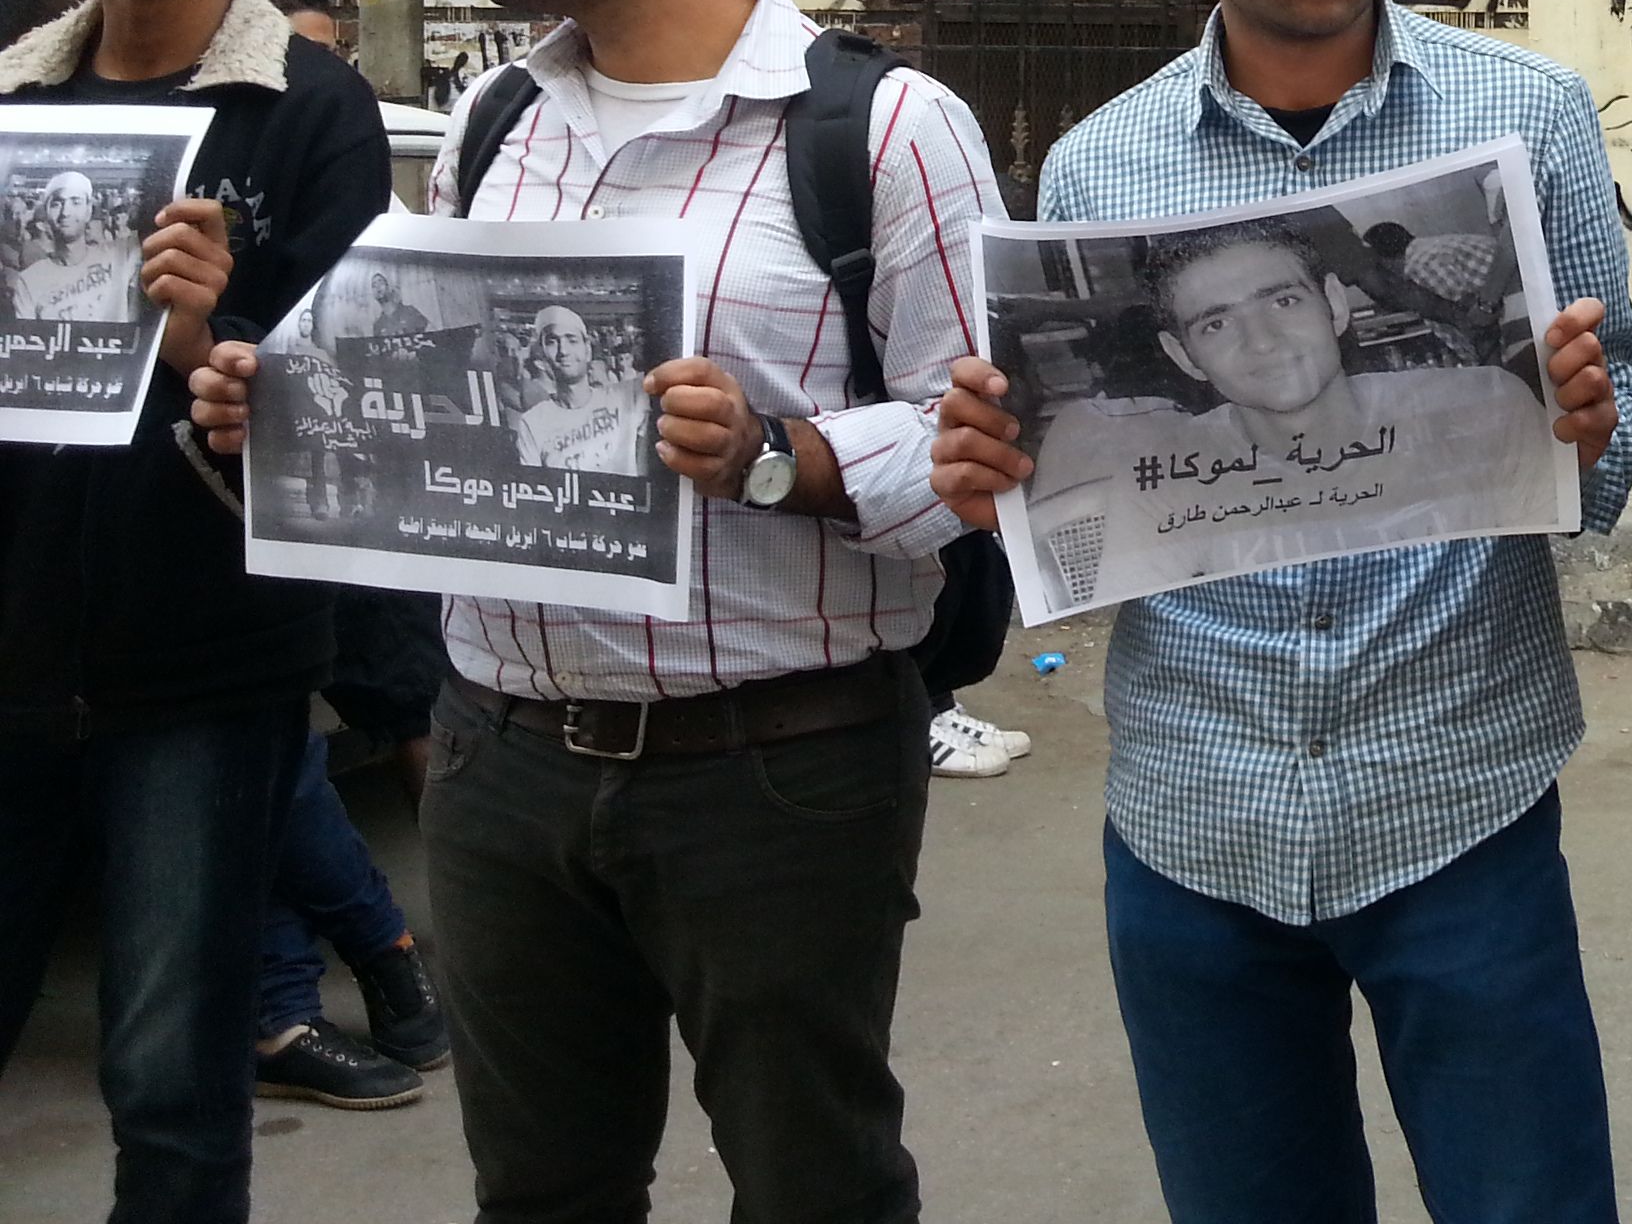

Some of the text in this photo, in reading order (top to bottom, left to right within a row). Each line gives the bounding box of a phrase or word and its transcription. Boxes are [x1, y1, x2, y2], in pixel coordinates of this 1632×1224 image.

[360, 370, 501, 440] الحرية
[423, 459, 495, 506] موكا
[501, 472, 580, 514] الرحمن
[1328, 483, 1384, 508] الحرية
[1156, 503, 1207, 534] طارق
[1211, 495, 1303, 524] عبدالرحمن
[465, 521, 502, 545] الجبهة
[505, 526, 538, 551] ابريل
